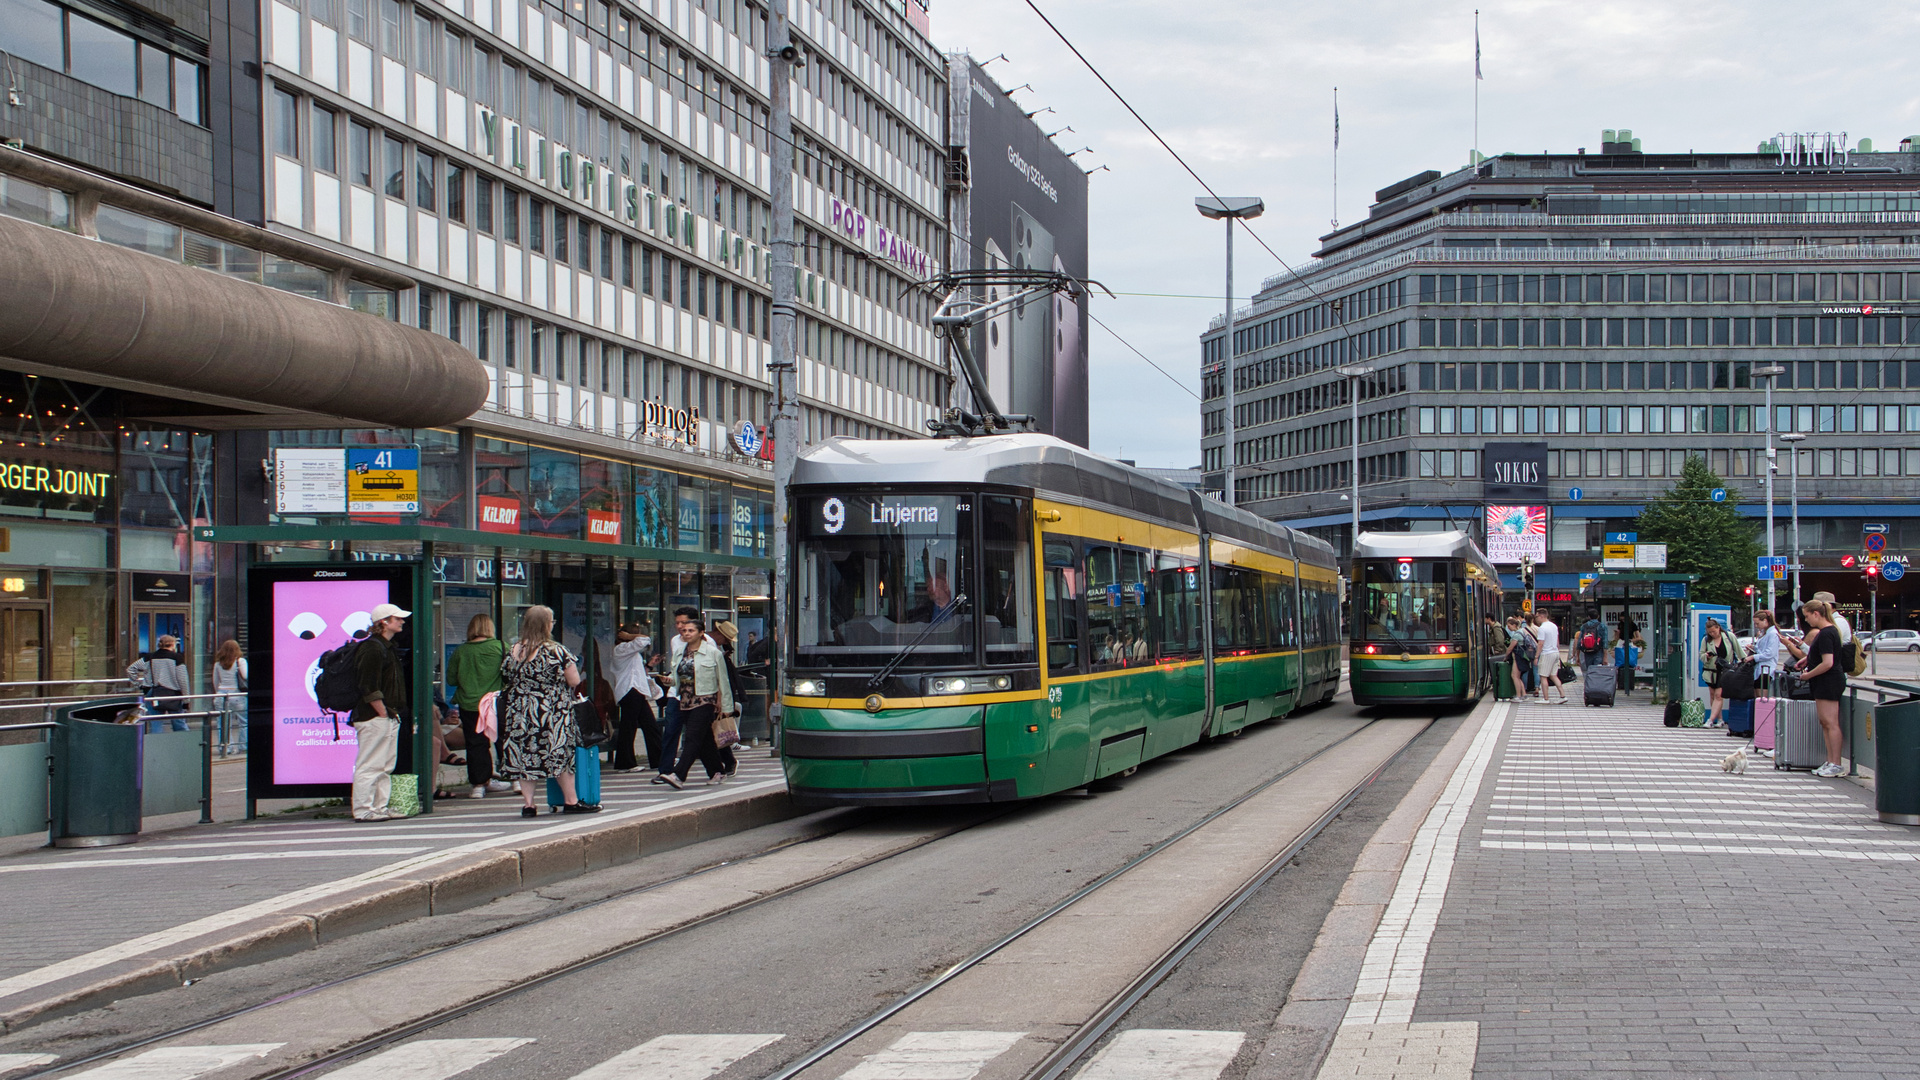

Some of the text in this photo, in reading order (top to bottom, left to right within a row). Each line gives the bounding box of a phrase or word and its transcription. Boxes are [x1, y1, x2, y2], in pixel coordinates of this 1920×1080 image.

[973, 78, 995, 108] SAMSUNG
[1775, 132, 1849, 166] SOKOS
[1007, 145, 1058, 203] Galaxy S23 Series
[481, 110, 826, 309] YLIOPISTON APTEKKI
[833, 199, 933, 279] POP PANKKI
[641, 396, 687, 435] pino
[279, 461, 285, 469] 3
[375, 451, 392, 468] 41
[279, 471, 285, 480] 5
[1494, 462, 1538, 483] SOKOS
[279, 481, 285, 490] 6
[279, 492, 285, 500] 7
[279, 502, 286, 511] 9
[733, 498, 751, 524] las
[822, 497, 845, 534] 9
[871, 503, 938, 527] Linjerna
[733, 523, 765, 548] hlsn
[1488, 535, 1544, 543] KUSTAA SAKSI
[1616, 533, 1627, 542] 42
[1858, 555, 1908, 563] VAKUNA
[501, 560, 526, 580] EA
[1399, 562, 1410, 580] 9
[1051, 706, 1062, 719] 412
